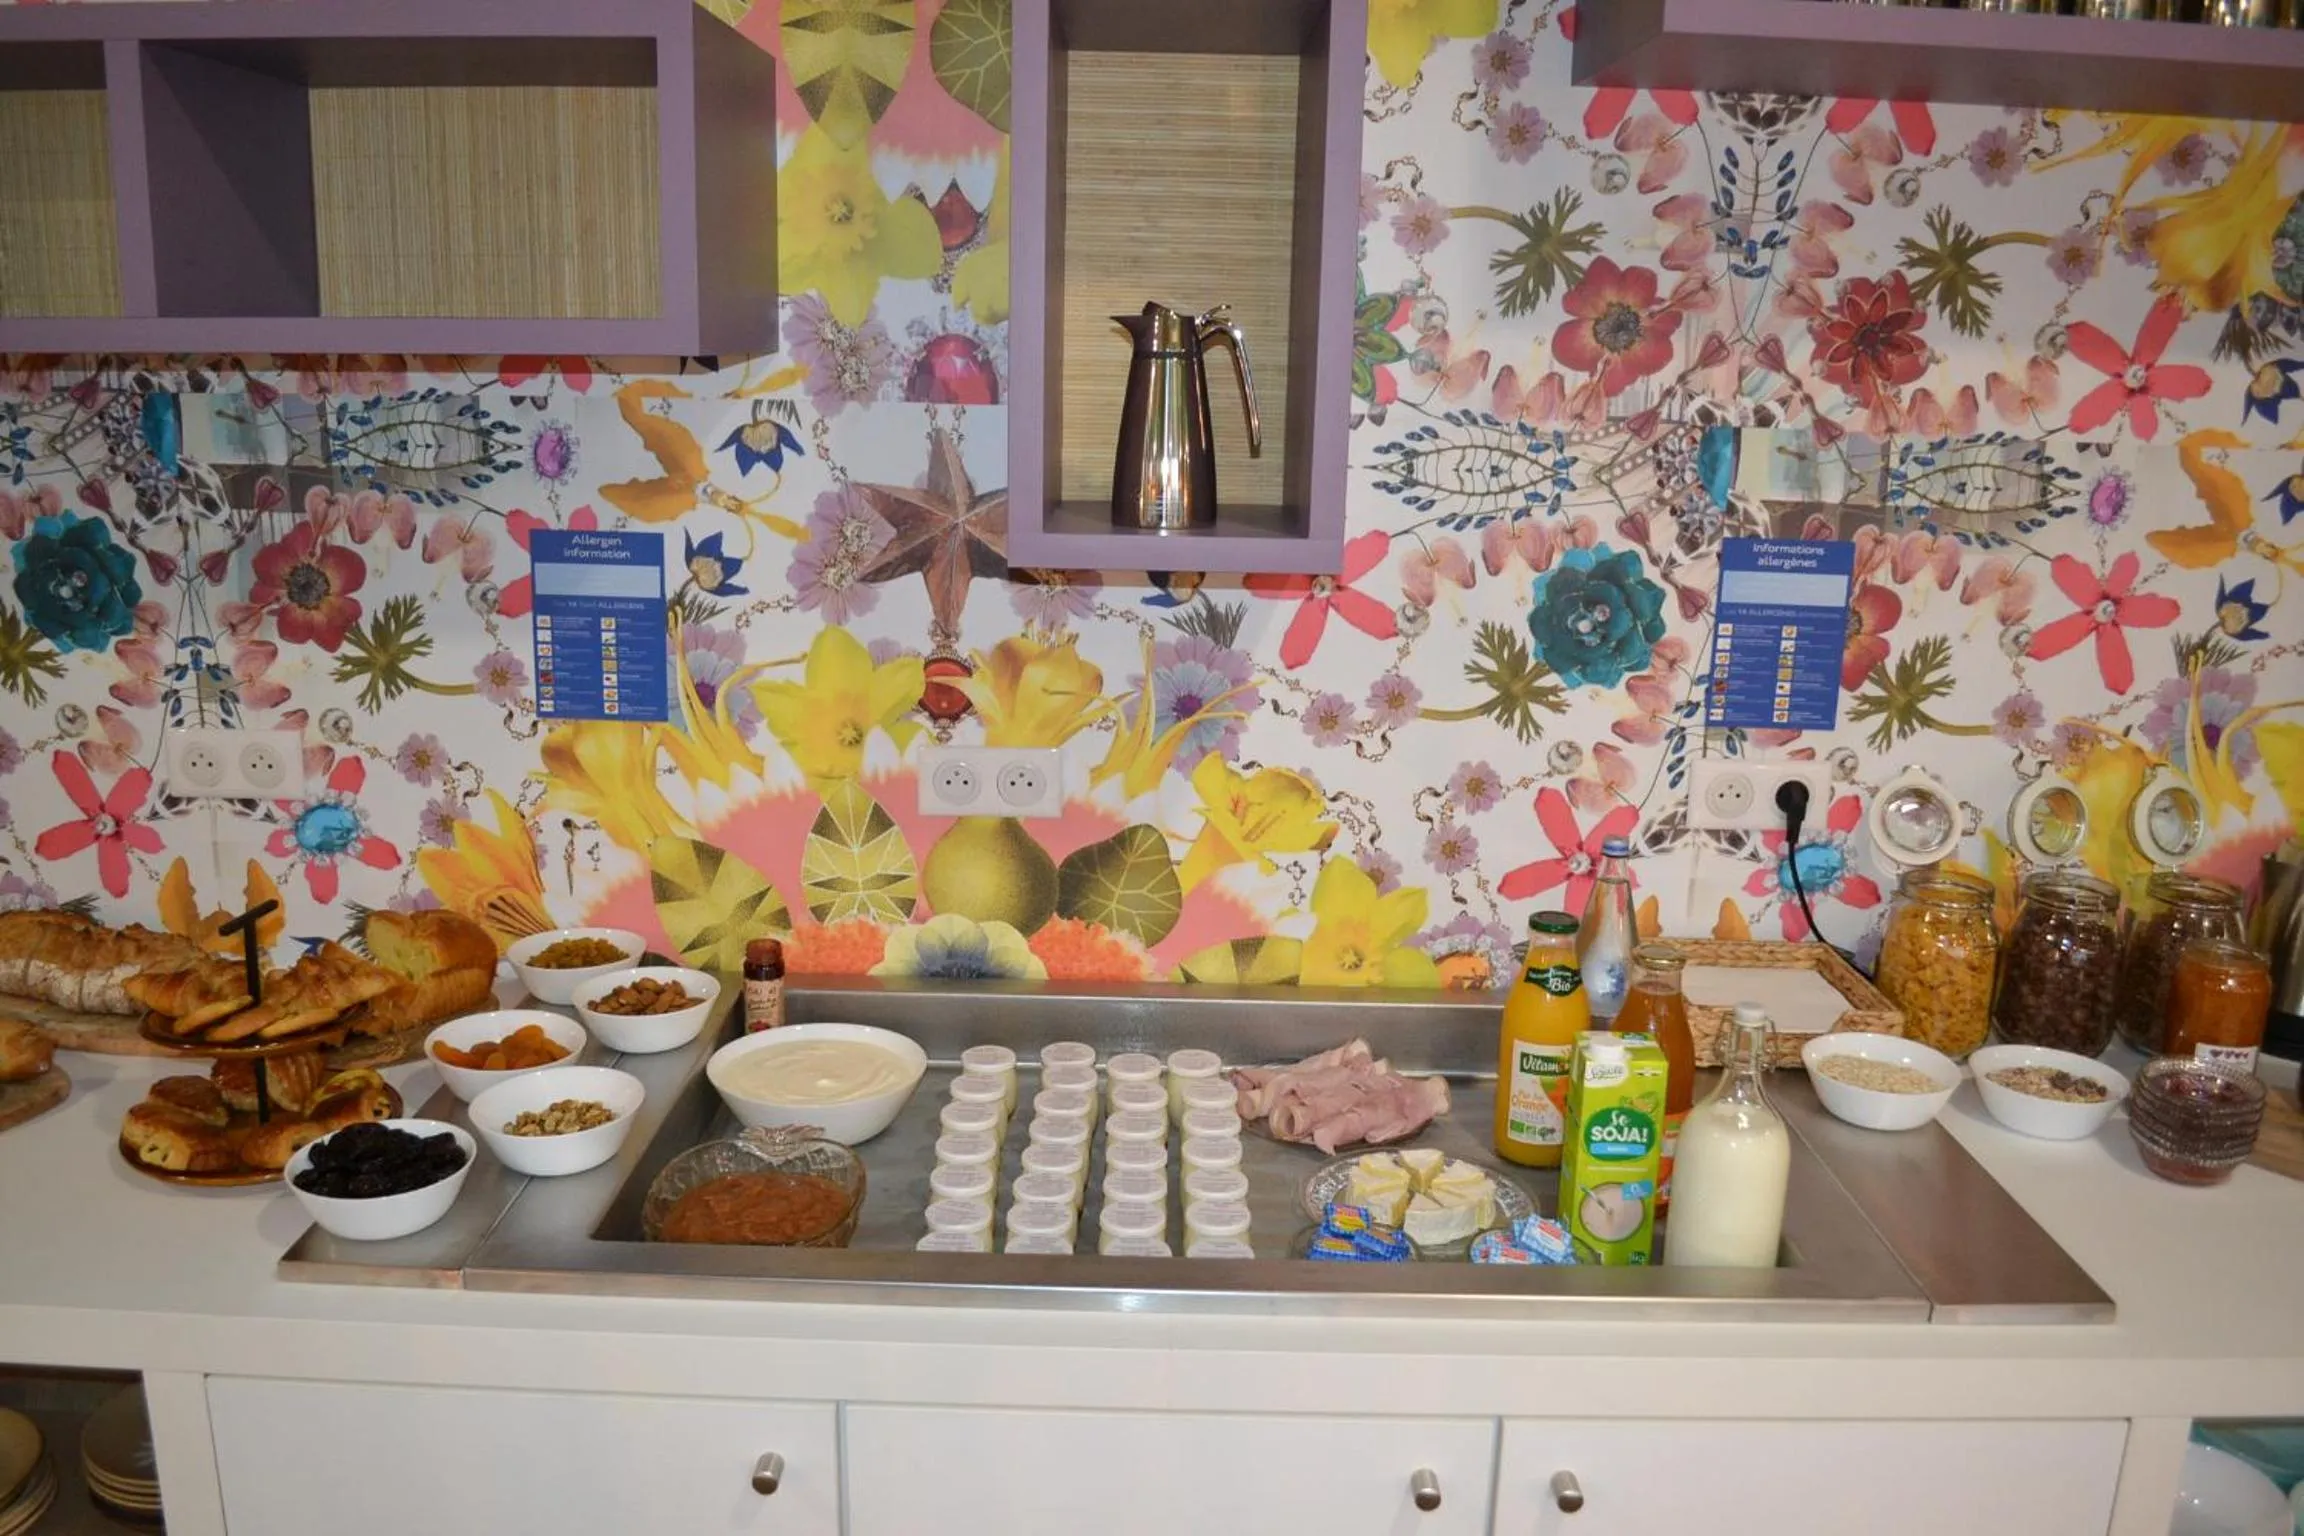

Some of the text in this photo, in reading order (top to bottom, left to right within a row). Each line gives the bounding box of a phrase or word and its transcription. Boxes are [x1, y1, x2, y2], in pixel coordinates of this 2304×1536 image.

[571, 534, 622, 549] Allergen
[1549, 978, 1571, 993] Bio
[1590, 1125, 1649, 1143] SOJA!
